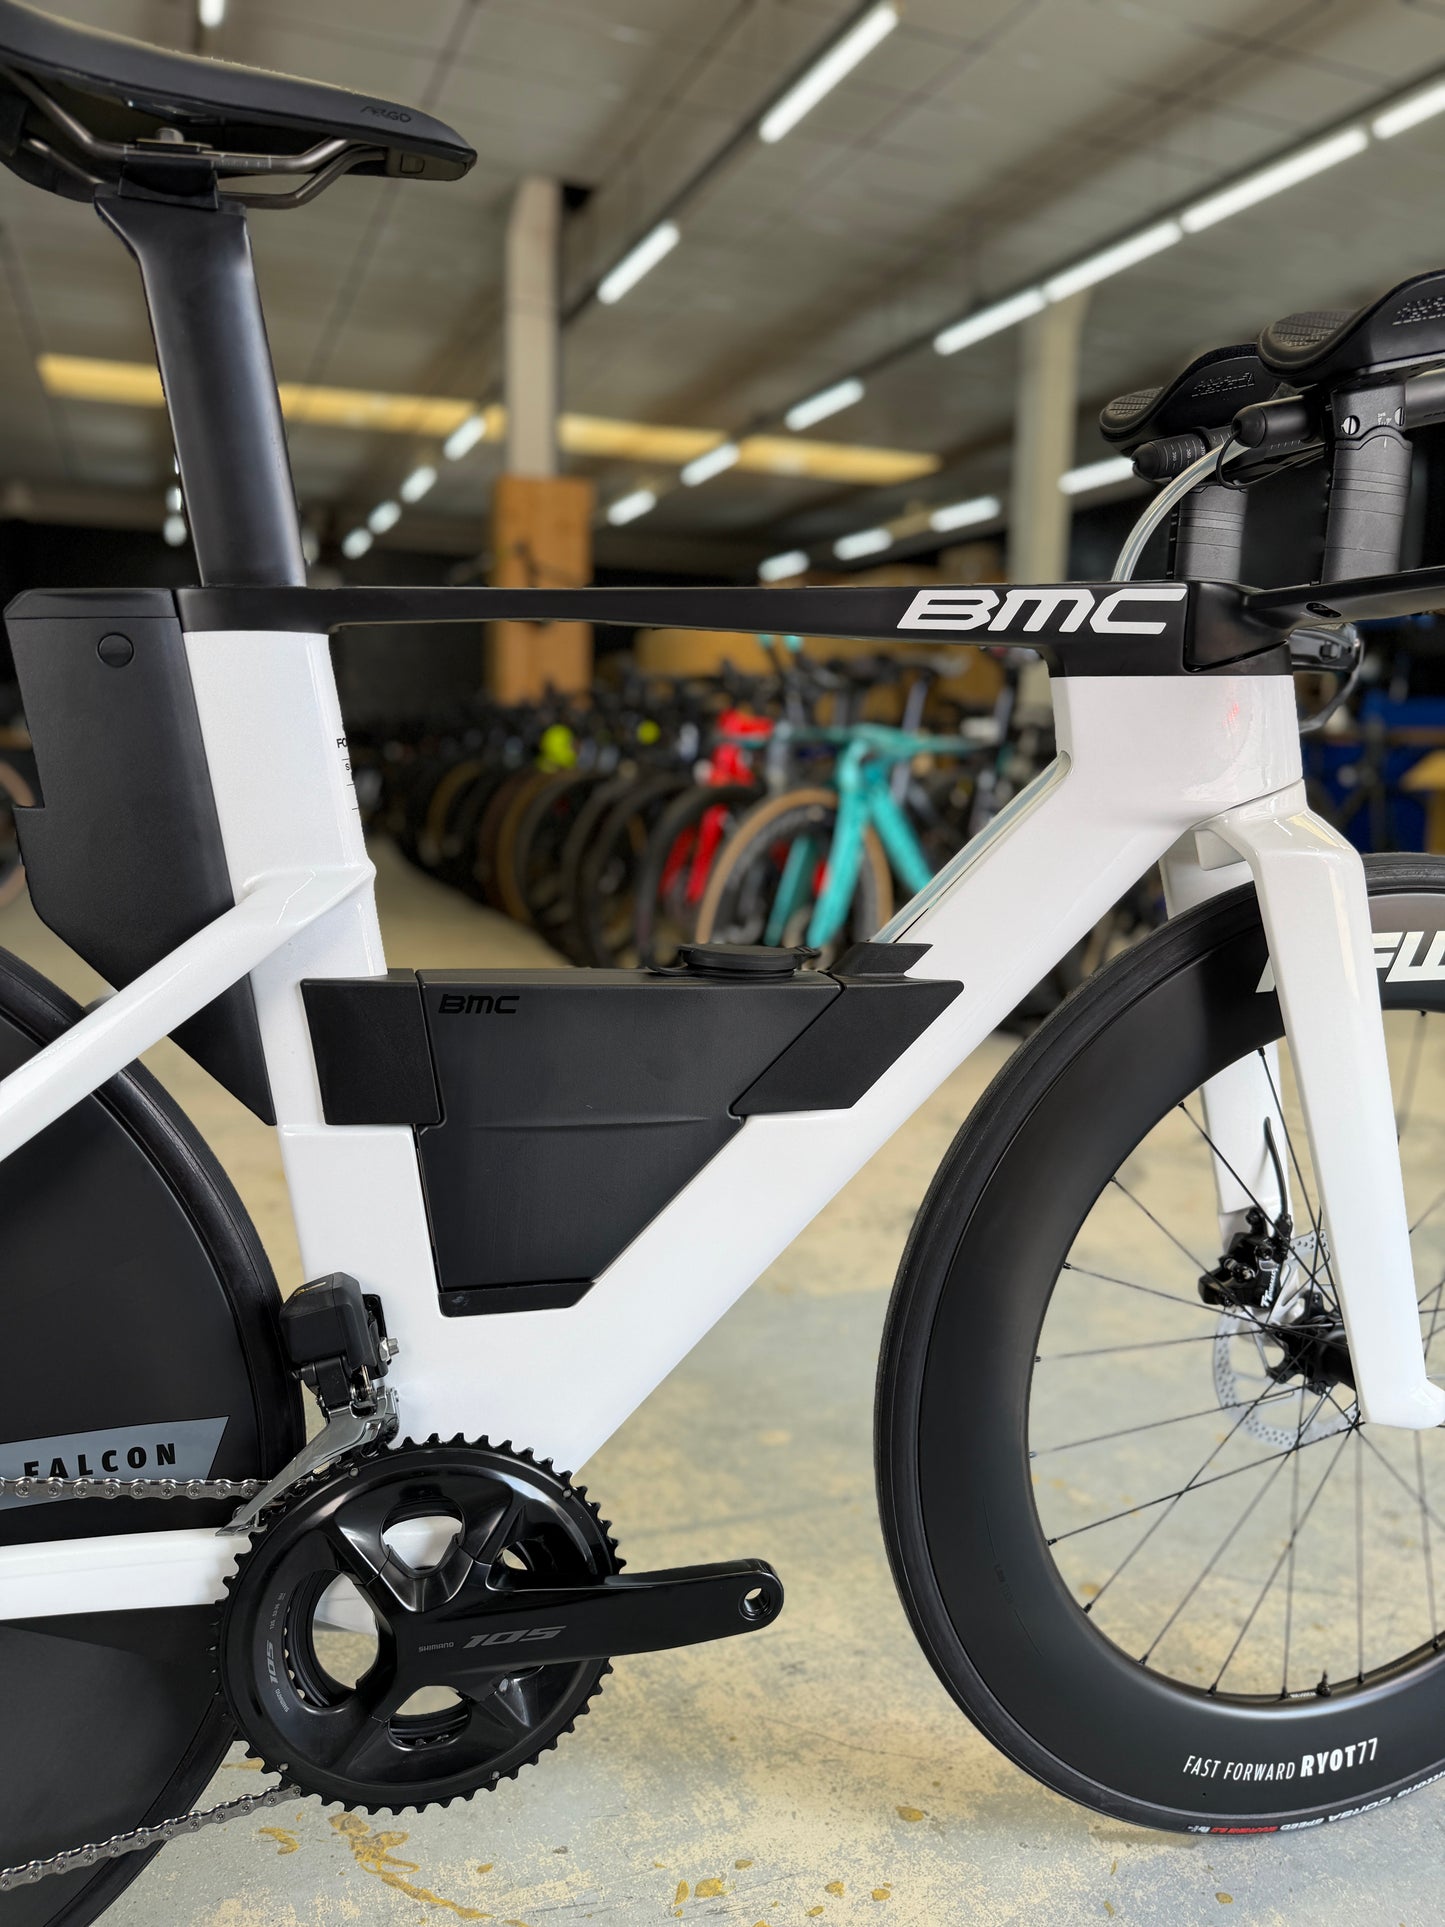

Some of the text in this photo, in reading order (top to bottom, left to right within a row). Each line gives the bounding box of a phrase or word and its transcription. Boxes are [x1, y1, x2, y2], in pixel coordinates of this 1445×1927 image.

[897, 588, 1187, 634] BMC
[438, 994, 520, 1014] BMC
[24, 1443, 176, 1478] FALCON
[418, 1625, 567, 1652] SHIMANO 105
[266, 1639, 279, 1684] 105
[1183, 1755, 1221, 1778] FAST
[1223, 1762, 1296, 1781] FORWARD
[1328, 1796, 1392, 1823] CORSA
